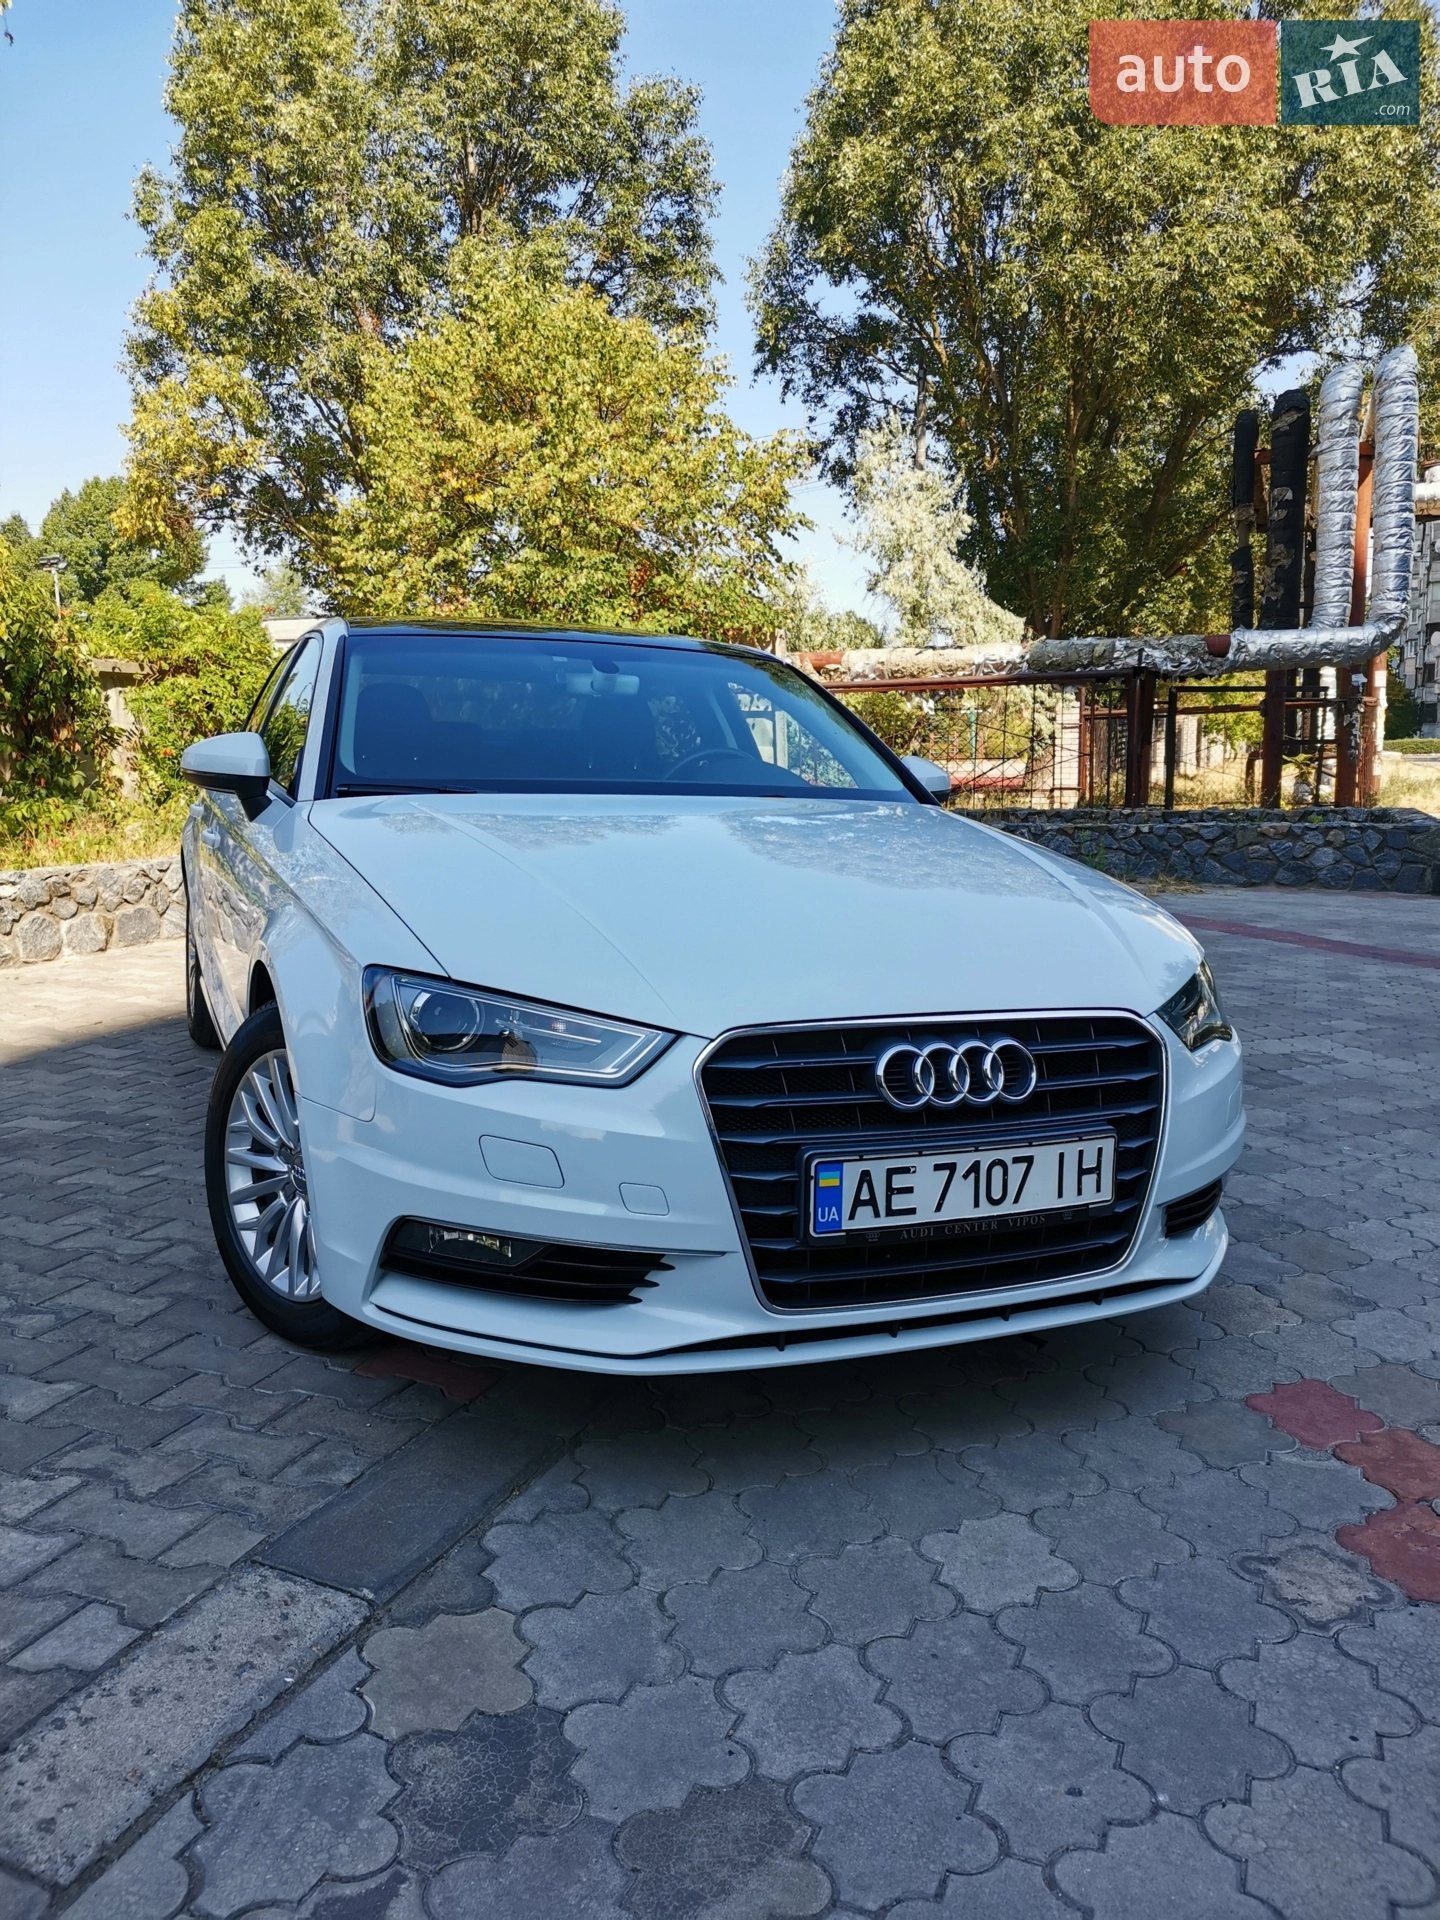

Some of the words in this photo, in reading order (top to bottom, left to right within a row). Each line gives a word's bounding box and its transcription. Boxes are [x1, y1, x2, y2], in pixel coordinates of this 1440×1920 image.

[848, 1165, 917, 1221] AE
[933, 1154, 1035, 1213] 7107
[1057, 1145, 1104, 1200] IH
[817, 1207, 840, 1223] UA
[900, 1226, 935, 1240] AUDI
[945, 1219, 999, 1236] CENTER
[1008, 1214, 1046, 1228] VIPOS
